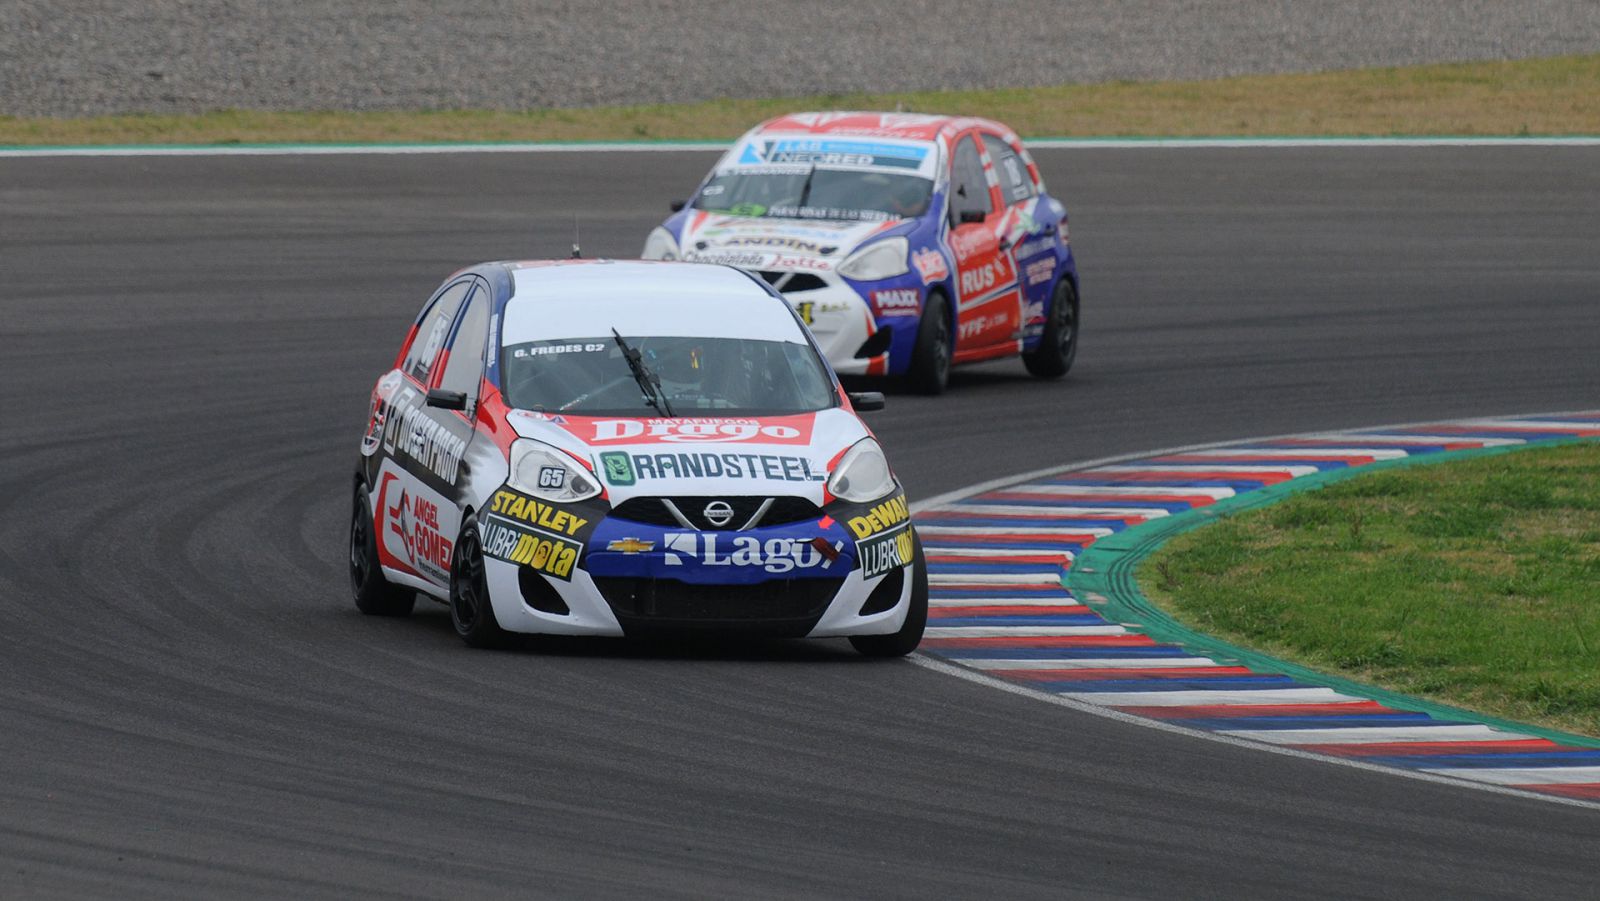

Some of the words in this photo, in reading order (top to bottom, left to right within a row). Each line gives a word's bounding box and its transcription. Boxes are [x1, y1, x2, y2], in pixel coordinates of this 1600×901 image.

[530, 344, 583, 356] FREDES
[591, 418, 801, 443] Drago
[647, 418, 761, 426] MATAFUEGOS
[539, 468, 565, 487] 65
[490, 490, 588, 536] STANLEY
